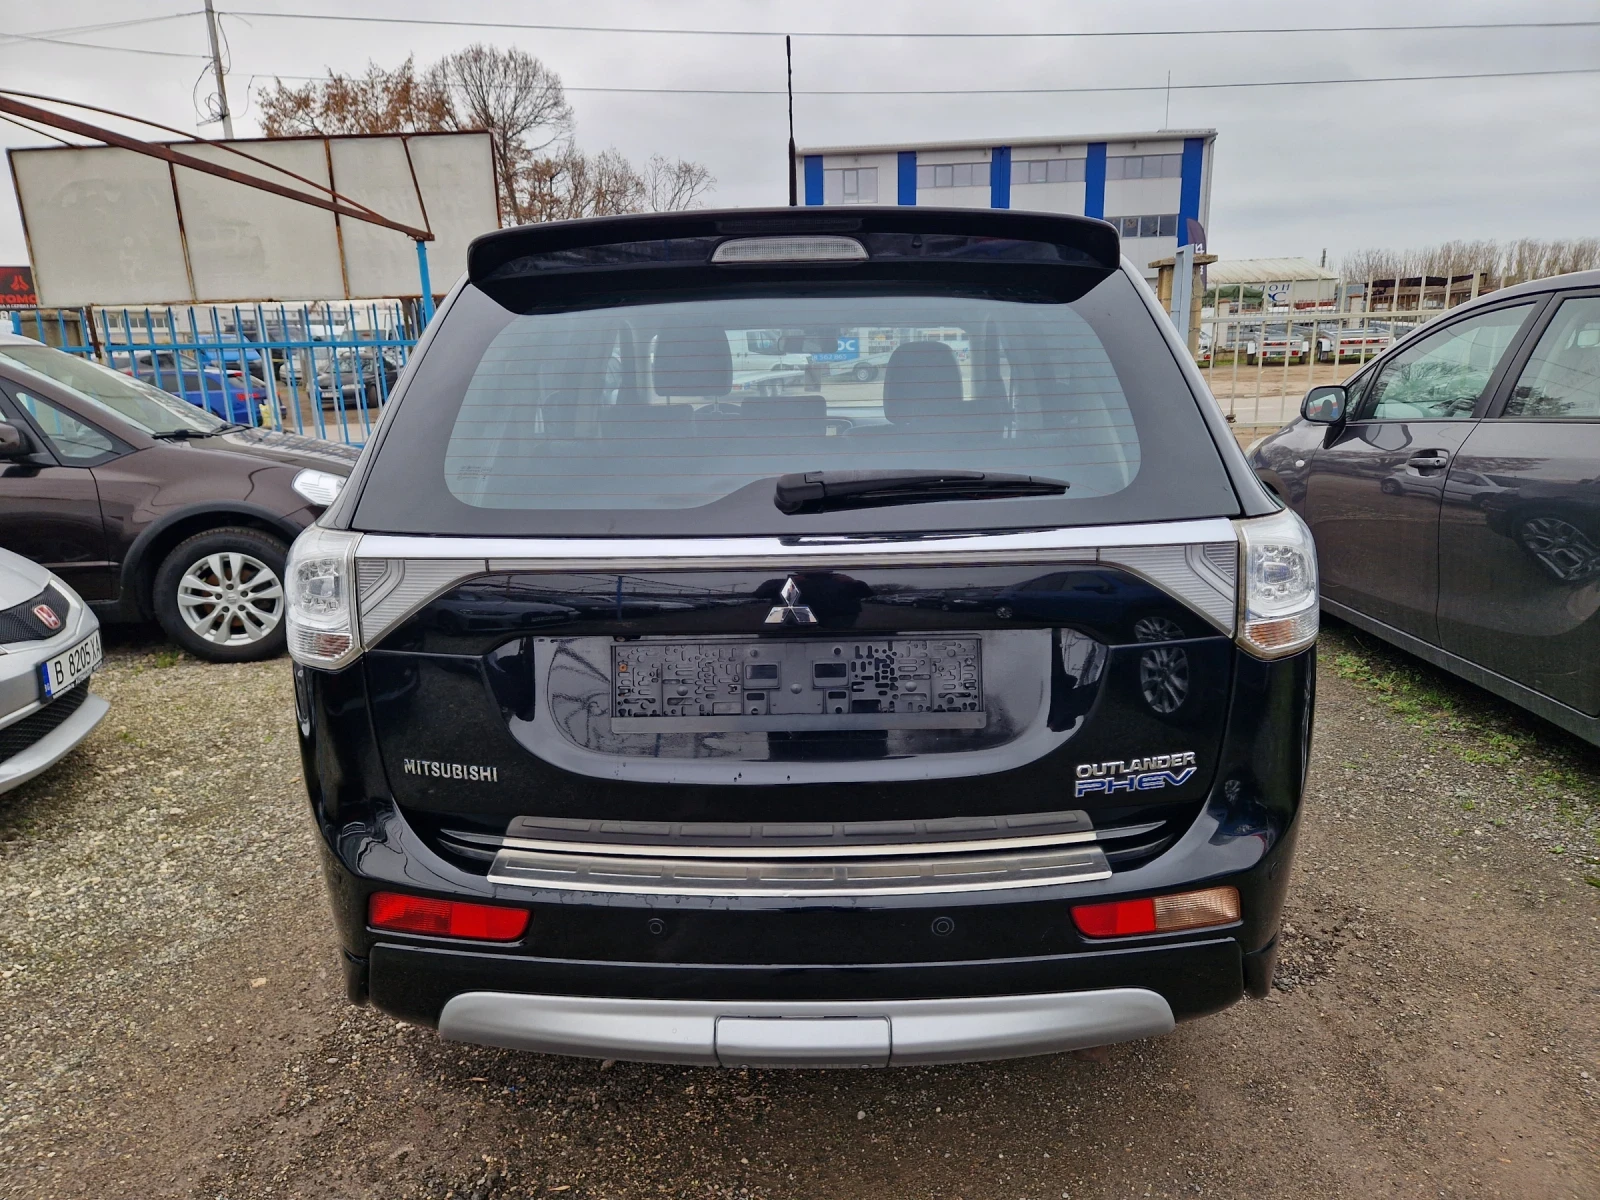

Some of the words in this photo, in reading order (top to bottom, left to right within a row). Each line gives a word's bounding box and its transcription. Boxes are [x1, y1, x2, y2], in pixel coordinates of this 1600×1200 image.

[54, 660, 65, 685] B
[68, 642, 91, 677] 8205
[90, 635, 101, 660] XA
[403, 758, 498, 782] MITSUBISHI
[1076, 751, 1196, 779] OUTLANDER
[1074, 766, 1198, 798] PHEV
